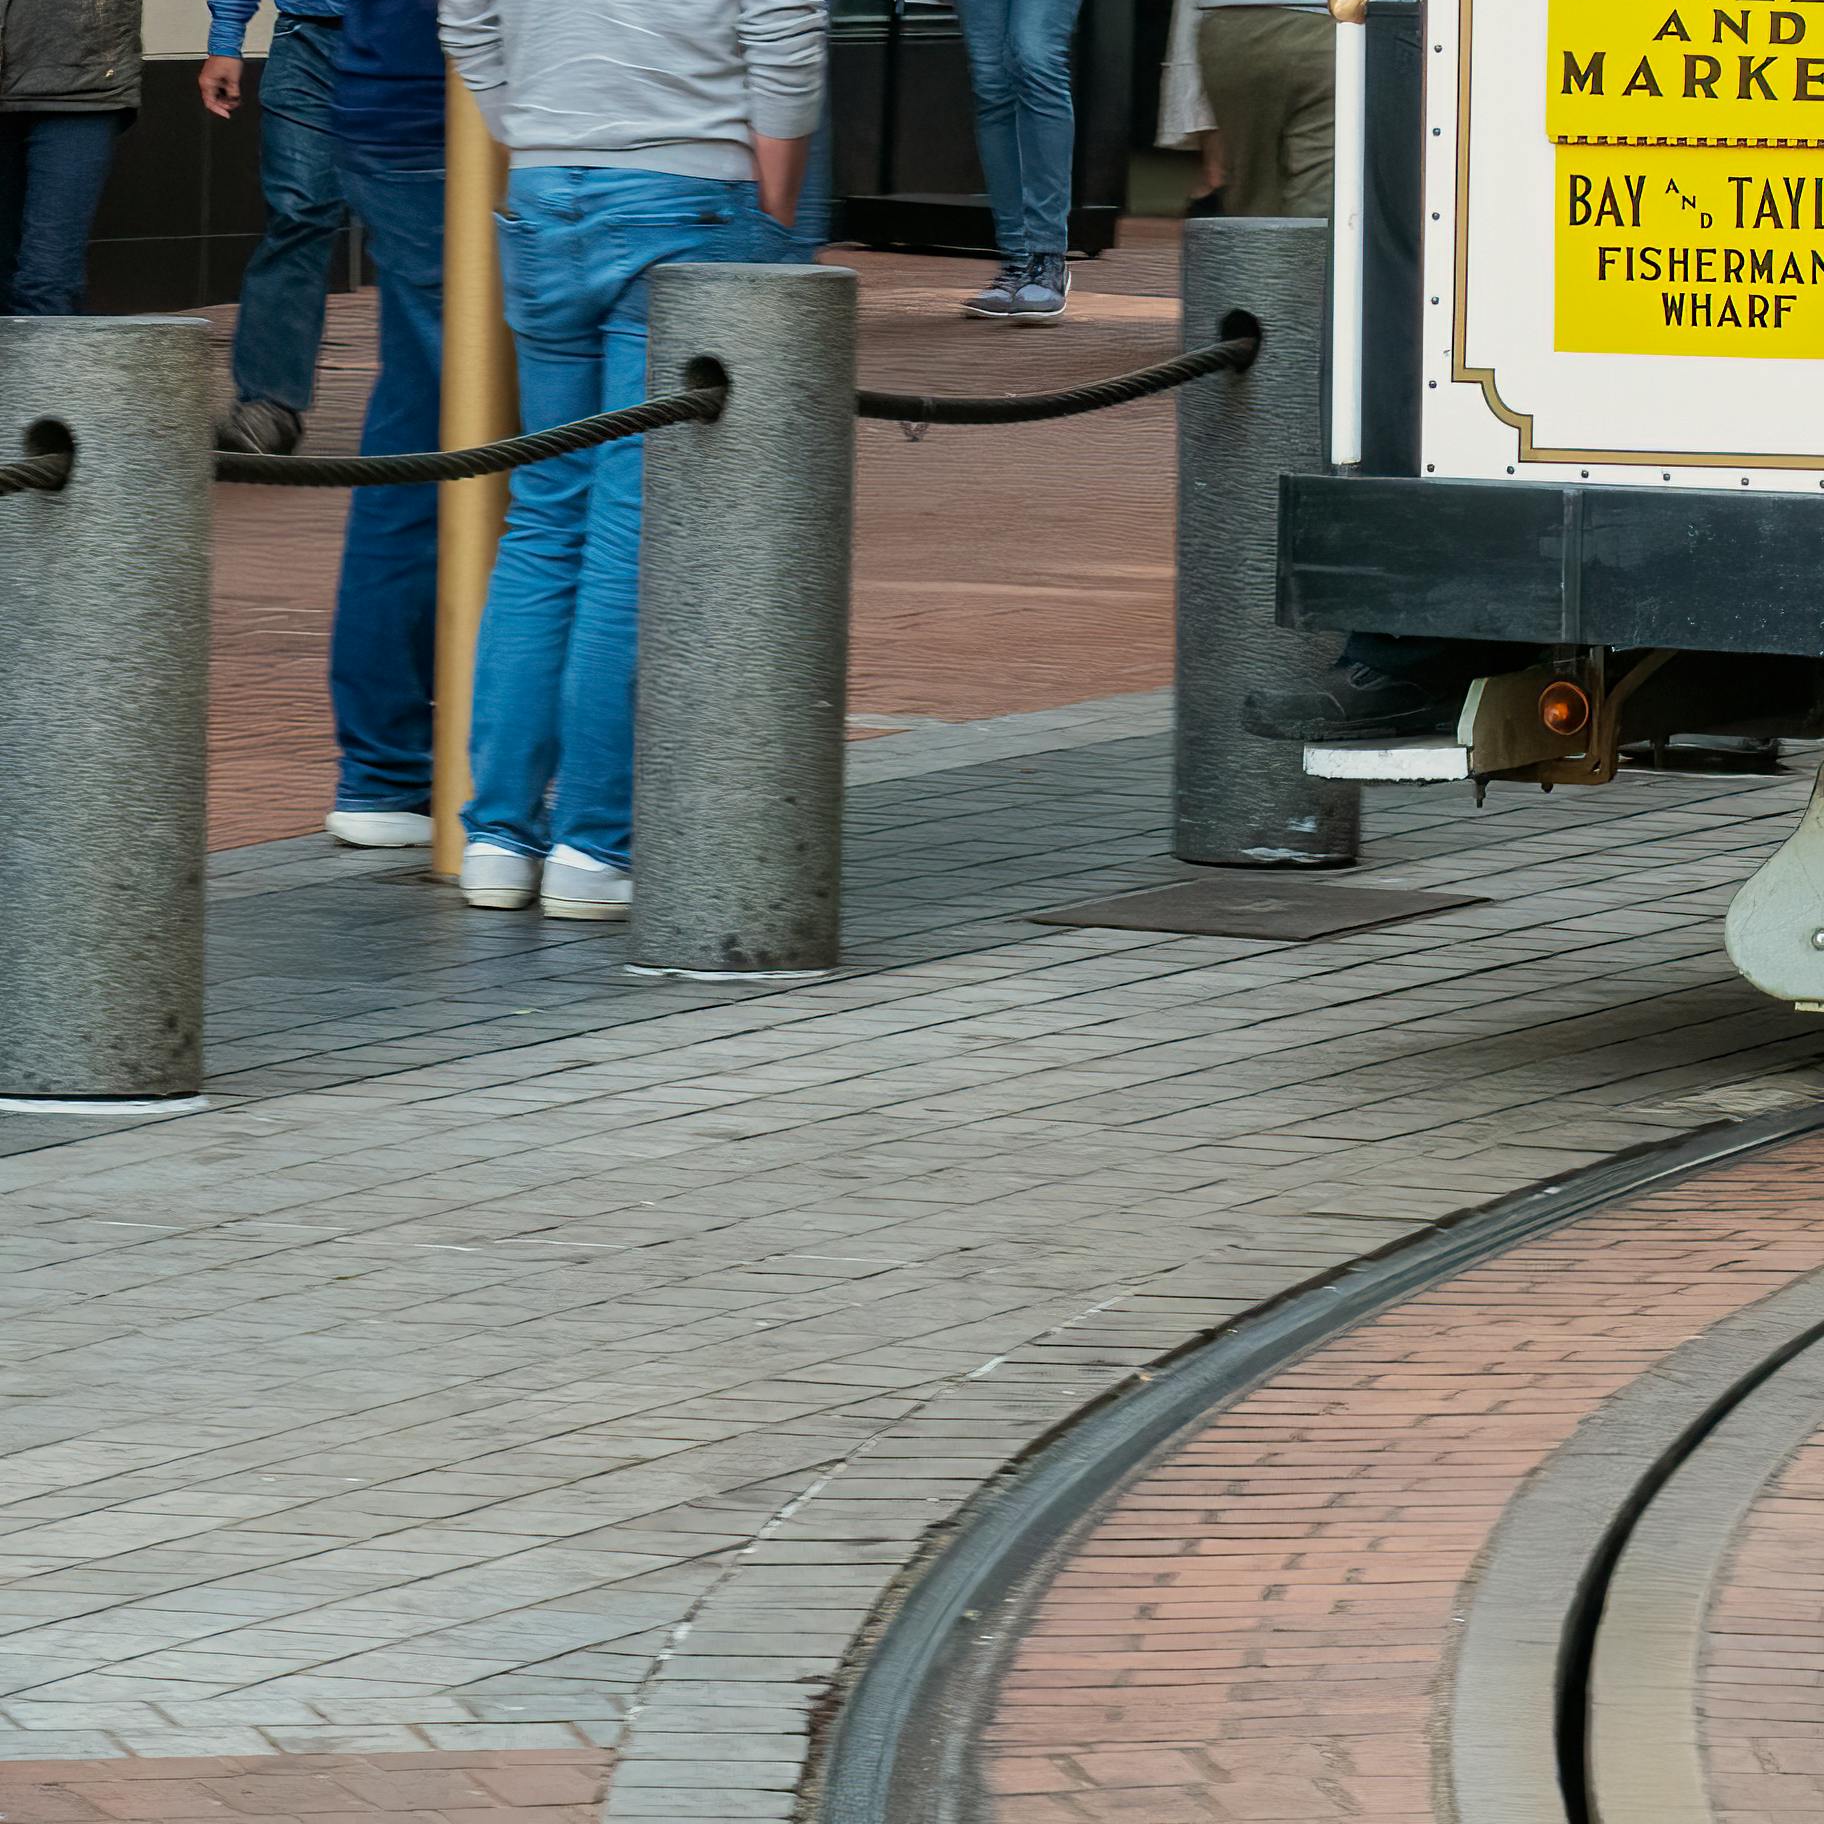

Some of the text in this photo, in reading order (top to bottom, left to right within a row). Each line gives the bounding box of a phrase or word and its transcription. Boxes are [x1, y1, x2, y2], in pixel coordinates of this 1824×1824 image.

[1652, 8, 1807, 45] AND
[1568, 173, 1647, 228] BAY
[1665, 177, 1714, 230] AND
[1660, 292, 1798, 329] WHARF
